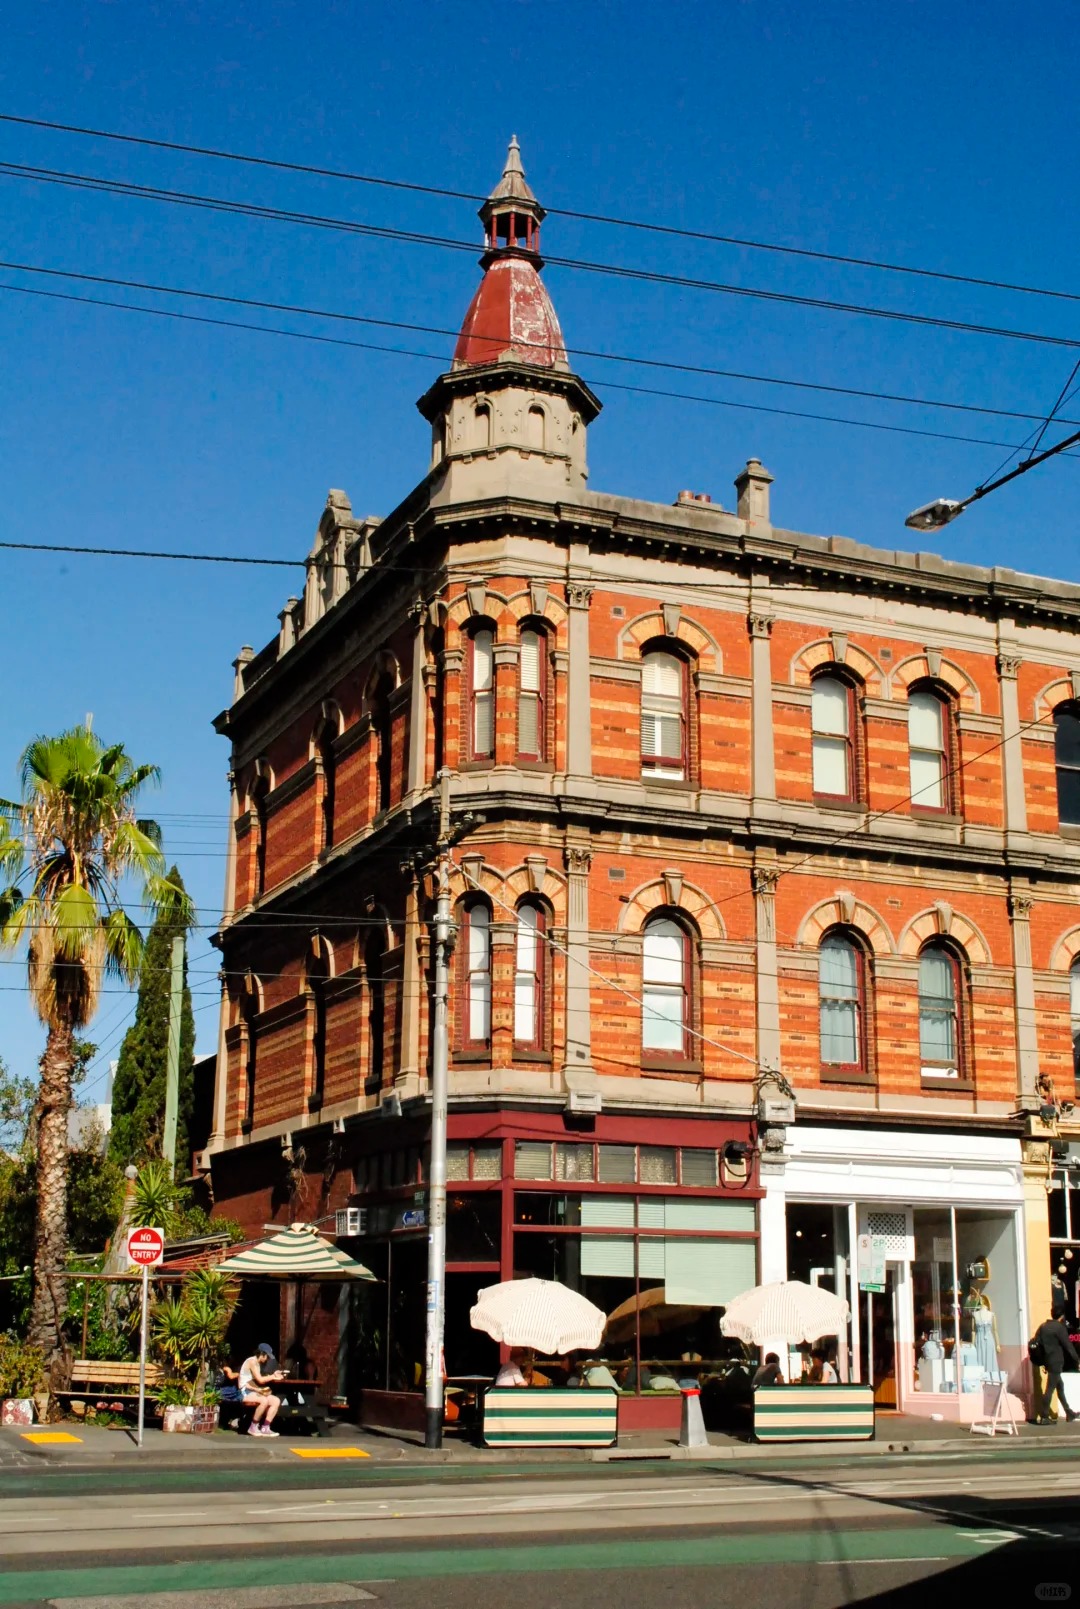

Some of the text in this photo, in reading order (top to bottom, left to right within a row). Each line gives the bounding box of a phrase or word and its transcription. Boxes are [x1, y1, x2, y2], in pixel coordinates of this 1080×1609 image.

[140, 1234, 152, 1242] NO
[873, 1239, 885, 1247] 2P
[132, 1250, 157, 1259] ENTRY
